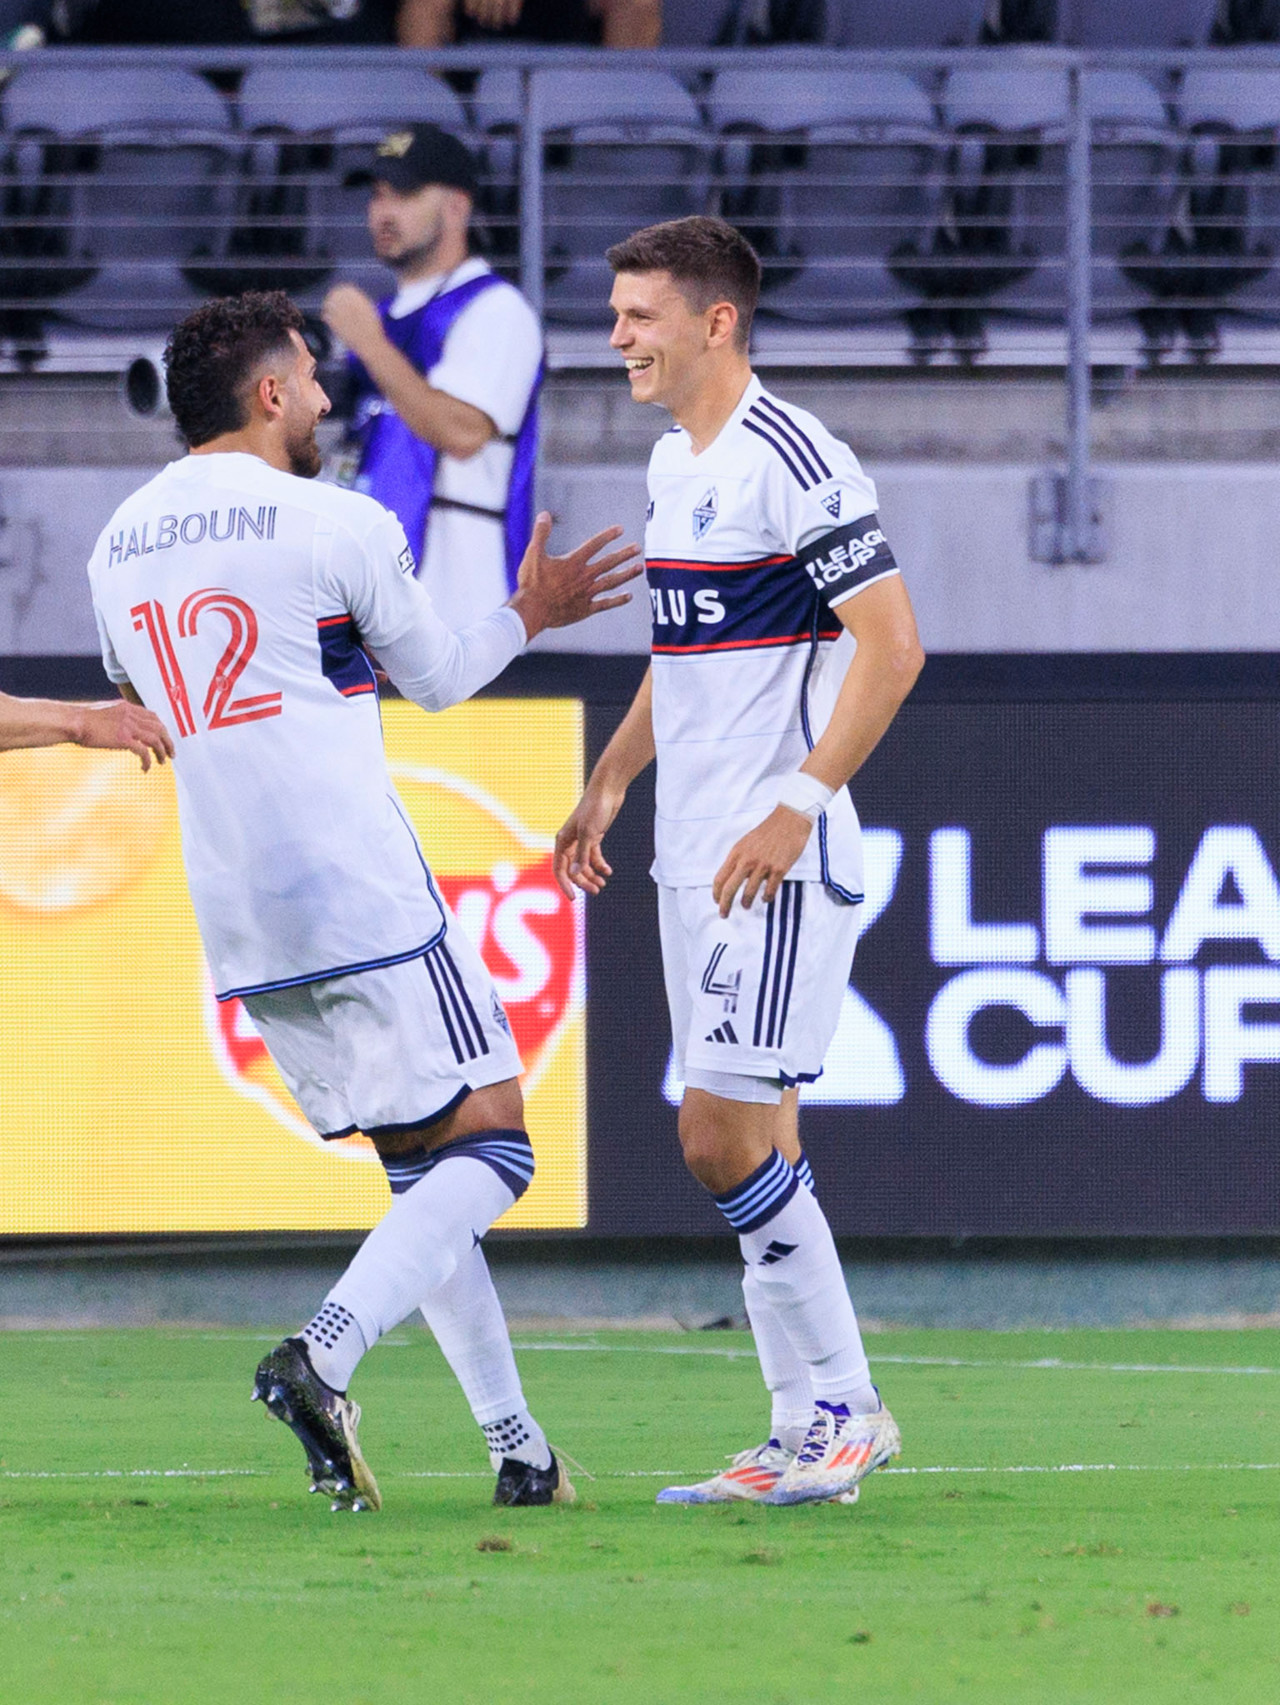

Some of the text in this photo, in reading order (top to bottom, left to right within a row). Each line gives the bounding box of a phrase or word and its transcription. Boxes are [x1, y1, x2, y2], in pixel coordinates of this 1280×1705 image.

[108, 506, 277, 568] HALBOUNI
[822, 547, 876, 583] CUP
[130, 587, 282, 738] 12
[701, 942, 742, 1014] 4
